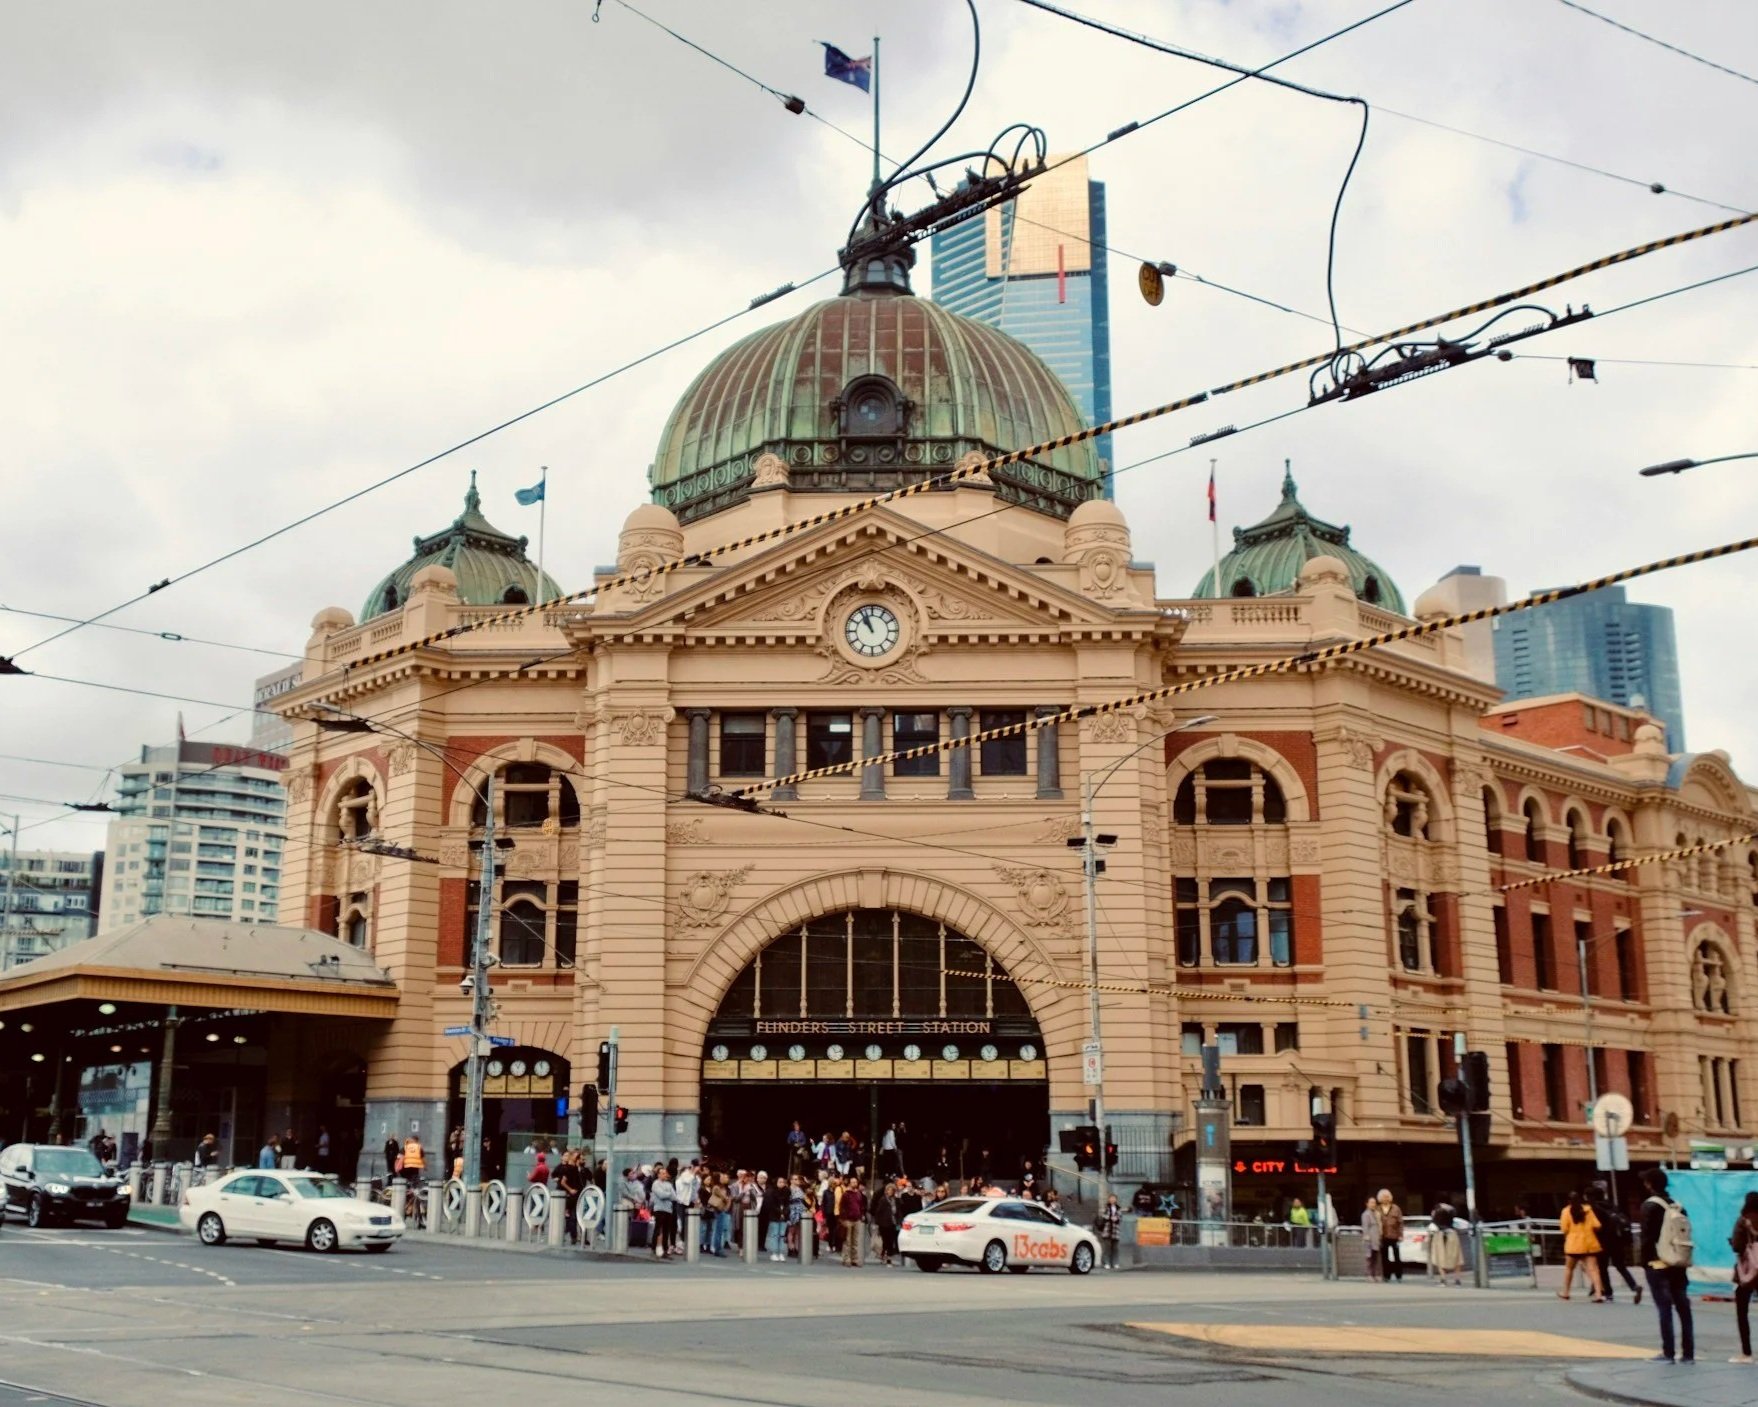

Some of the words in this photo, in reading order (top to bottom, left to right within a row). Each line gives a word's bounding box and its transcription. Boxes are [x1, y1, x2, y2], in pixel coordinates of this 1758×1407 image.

[756, 1021, 829, 1034] FLINDERS
[848, 1021, 904, 1034] STREET
[922, 1021, 990, 1034] STATION
[1252, 1161, 1285, 1173] CITY
[1014, 1234, 1068, 1259] 13cabs
